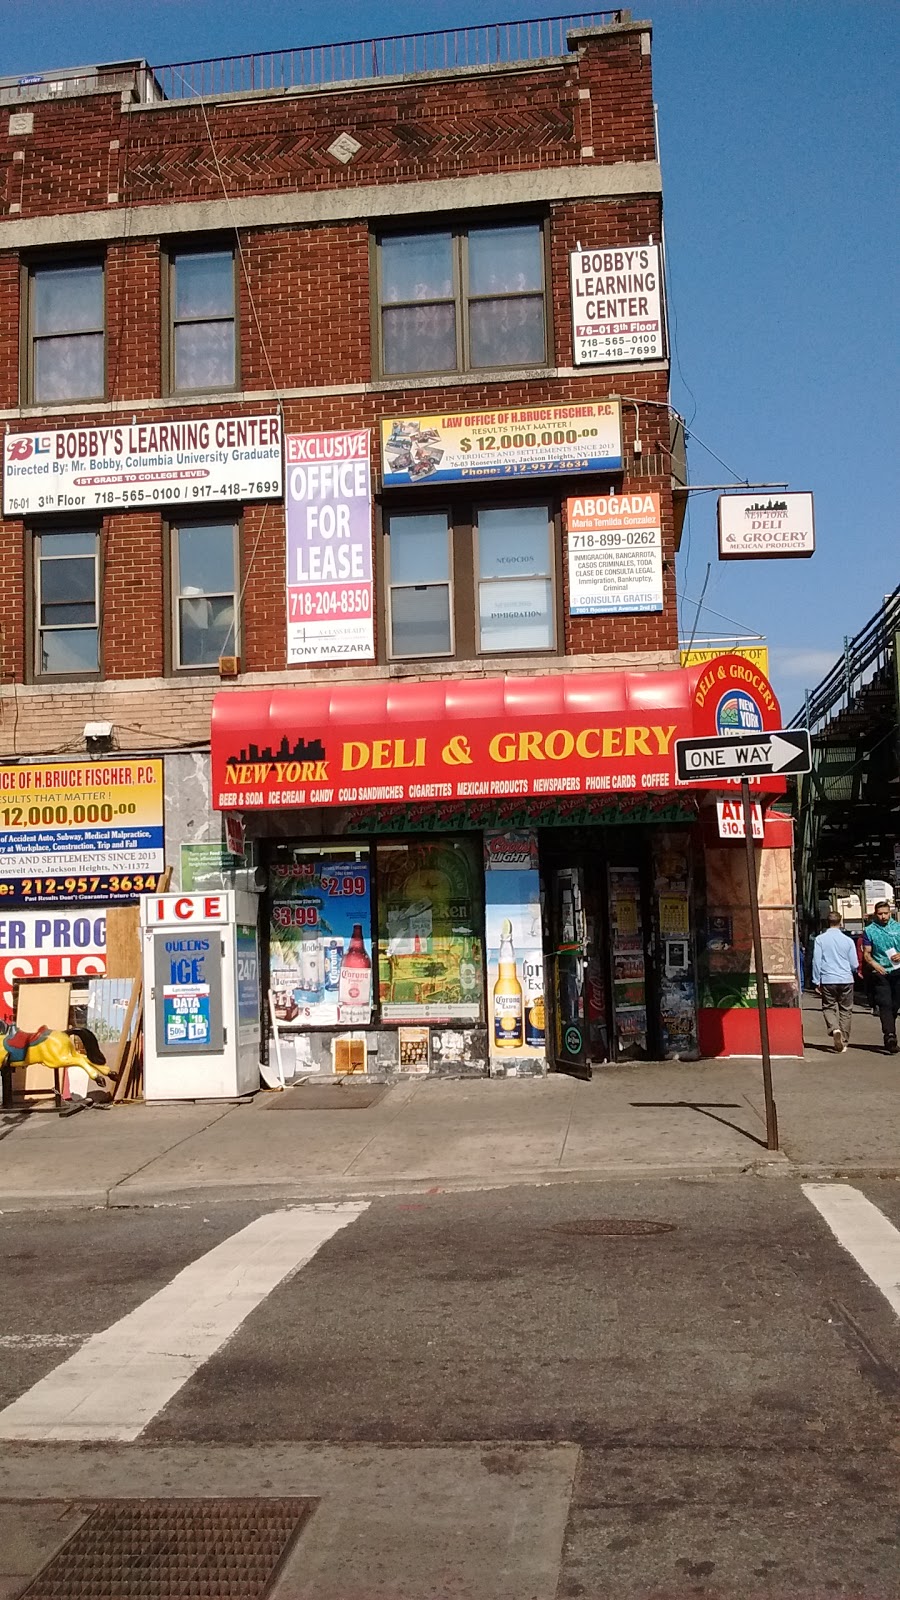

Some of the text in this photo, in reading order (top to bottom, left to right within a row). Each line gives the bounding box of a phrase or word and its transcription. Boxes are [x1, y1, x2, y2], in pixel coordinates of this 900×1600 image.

[581, 250, 649, 274] BOBBY'S
[576, 272, 656, 297] LEARNING
[586, 297, 649, 320] CENTER
[579, 325, 610, 336] 76-01
[630, 322, 656, 332] Floor
[580, 334, 656, 348] 718-565-0100
[581, 346, 656, 358] 917-418-7699
[442, 404, 614, 428] LAW OFFICE OF H.BRUCE FISCHER, P.C.
[472, 422, 567, 435] RESULTS THAT MATTER
[56, 418, 280, 460] BOBBY'S LEARNING CENTER
[288, 434, 367, 460] EXCLUSIVE
[460, 428, 598, 453] $ 12,000,000.00
[6, 448, 280, 476] Directed By: Mr. Bobby, Columbia University Graduate
[520, 454, 546, 464] Jackson
[462, 466, 500, 476] Phone:
[504, 460, 590, 473] 212-957-3634
[94, 469, 208, 484] GRADE TO COLLEGE LEVEL
[290, 462, 368, 501] OFFICE
[38, 494, 54, 508] 3th
[58, 494, 86, 506] Floor
[95, 486, 181, 504] 718-565-0100
[192, 481, 280, 498] 917-418-7699
[572, 496, 655, 516] ABOGADA
[306, 504, 351, 540] FOR
[572, 516, 656, 528] Maria Gonzalez
[744, 510, 789, 520] NEW YORK
[752, 520, 782, 530] DELI
[572, 532, 656, 548] 718-899-0262
[726, 532, 808, 542] & GROCERY
[296, 543, 364, 582] LEASE
[616, 551, 656, 560] BANCARROTA,
[598, 560, 636, 568] CRIMINALES,
[604, 568, 636, 576] CONSULTA
[290, 588, 369, 616] 718-204-8350
[580, 594, 653, 605] CONSULTA GRATIS
[290, 644, 371, 656] TONY MAZZARA
[695, 664, 776, 712] DELI & GROCERY
[738, 698, 755, 712] NEW
[740, 711, 759, 728] YORK
[224, 725, 678, 785] NEW YORK DELI & GROCERY
[690, 746, 772, 768] ONE WAY
[20, 772, 32, 789] OF
[34, 769, 82, 788] H.BRUCE
[85, 767, 135, 786] FISCHER,
[137, 766, 156, 784] P.C.
[34, 792, 106, 802] THAT MATTER
[219, 793, 238, 806] BEER
[245, 792, 264, 805] SODA
[268, 790, 281, 804] ICE
[282, 790, 306, 804] CREAM
[310, 788, 334, 802] CANDY
[338, 788, 358, 802] COLD
[358, 786, 404, 800] SANDWICHES
[408, 782, 452, 798] CIGARETTES
[457, 780, 488, 796] MEXICAN
[490, 779, 528, 794] PRODUCTS
[533, 777, 581, 792] NEWSPAPERS
[586, 776, 611, 790] PHONE
[612, 774, 636, 788] CARDS
[641, 773, 670, 788] COFFEE
[1, 803, 136, 828] 12,000,000.00
[1, 830, 152, 843] of Accident Auto, Subway, Medical Malpractice,
[16, 844, 52, 853] Workplace,
[52, 842, 96, 852] Construction,
[97, 842, 110, 850] Trip
[125, 840, 138, 848] Fall
[490, 837, 529, 853] Coors
[18, 852, 156, 865] AND SETTLEMENTS SINCE 2013
[491, 852, 528, 862] LIGHT
[28, 862, 150, 874] Ave, Jackson Heights, NY-11372
[20, 874, 157, 895] 212-957-3634
[321, 876, 366, 896] $2.99
[157, 897, 222, 920] ICE
[273, 906, 318, 926] $3.99
[0, 920, 26, 949] ER
[164, 938, 210, 952] QUEENS
[170, 956, 206, 985] ICE
[173, 998, 200, 1008] DATA
